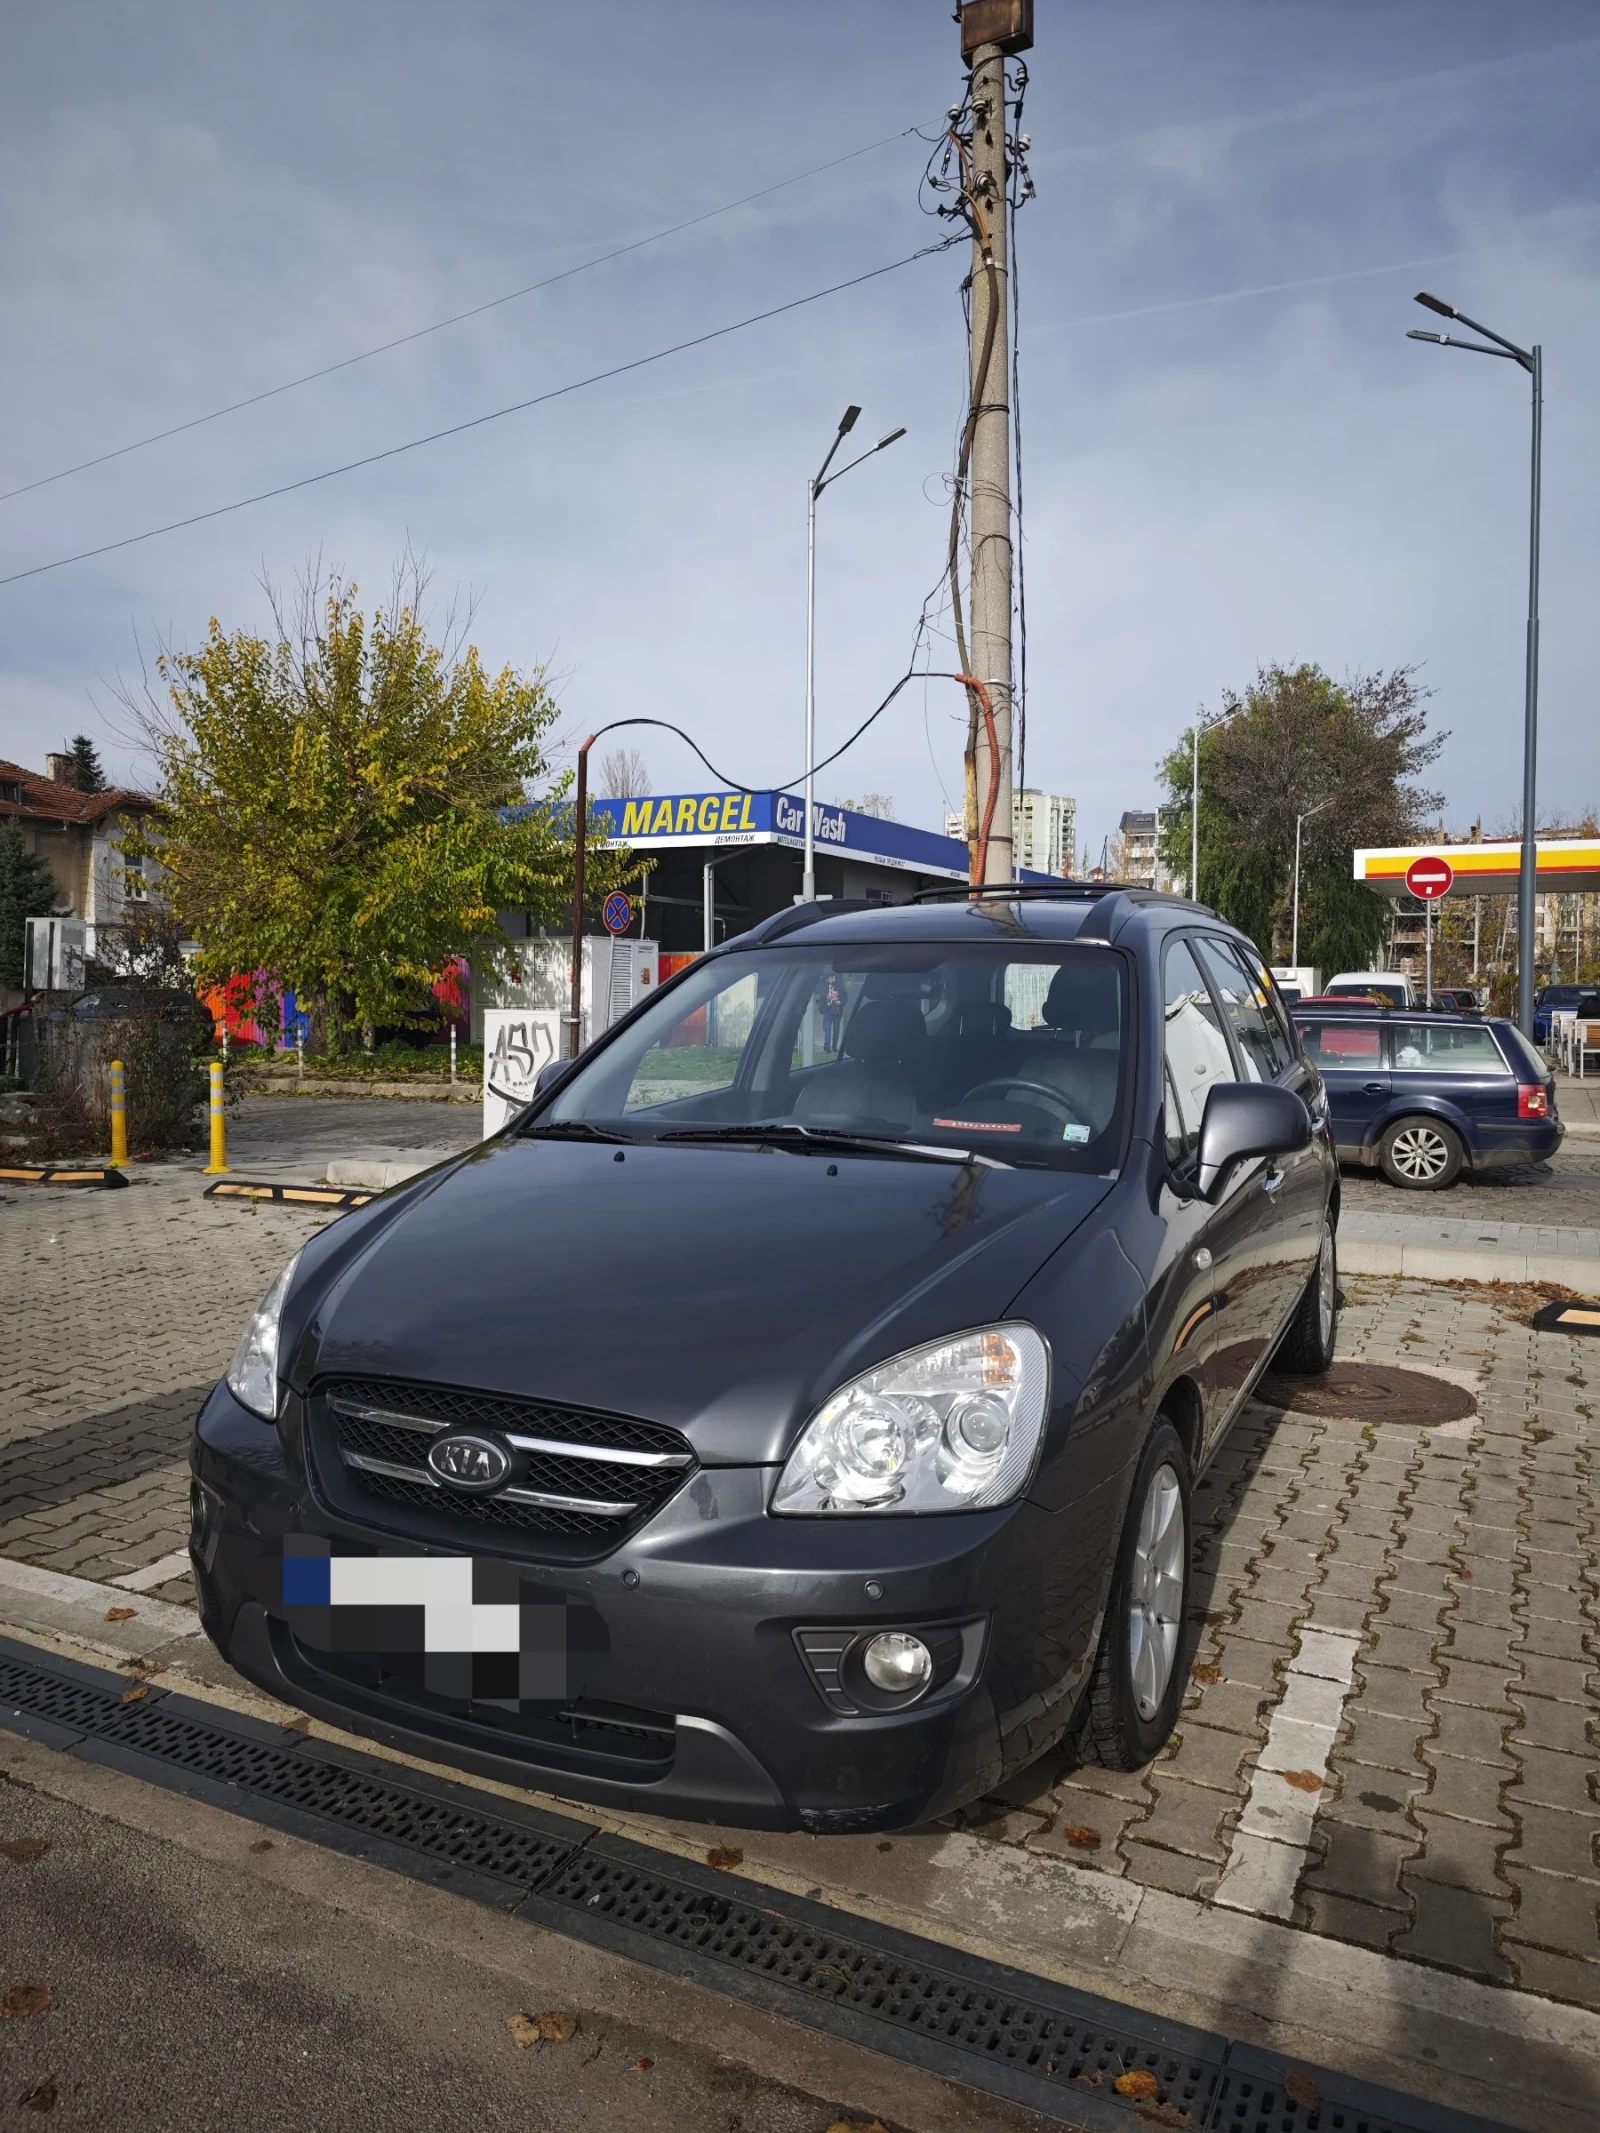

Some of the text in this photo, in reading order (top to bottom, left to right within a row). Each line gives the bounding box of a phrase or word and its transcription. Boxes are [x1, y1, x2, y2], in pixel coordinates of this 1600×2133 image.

[621, 795, 756, 836] MARGEL
[776, 796, 804, 833] Car
[714, 834, 755, 845] ДЕМОНТАЖ
[441, 1445, 491, 1479] KIA
